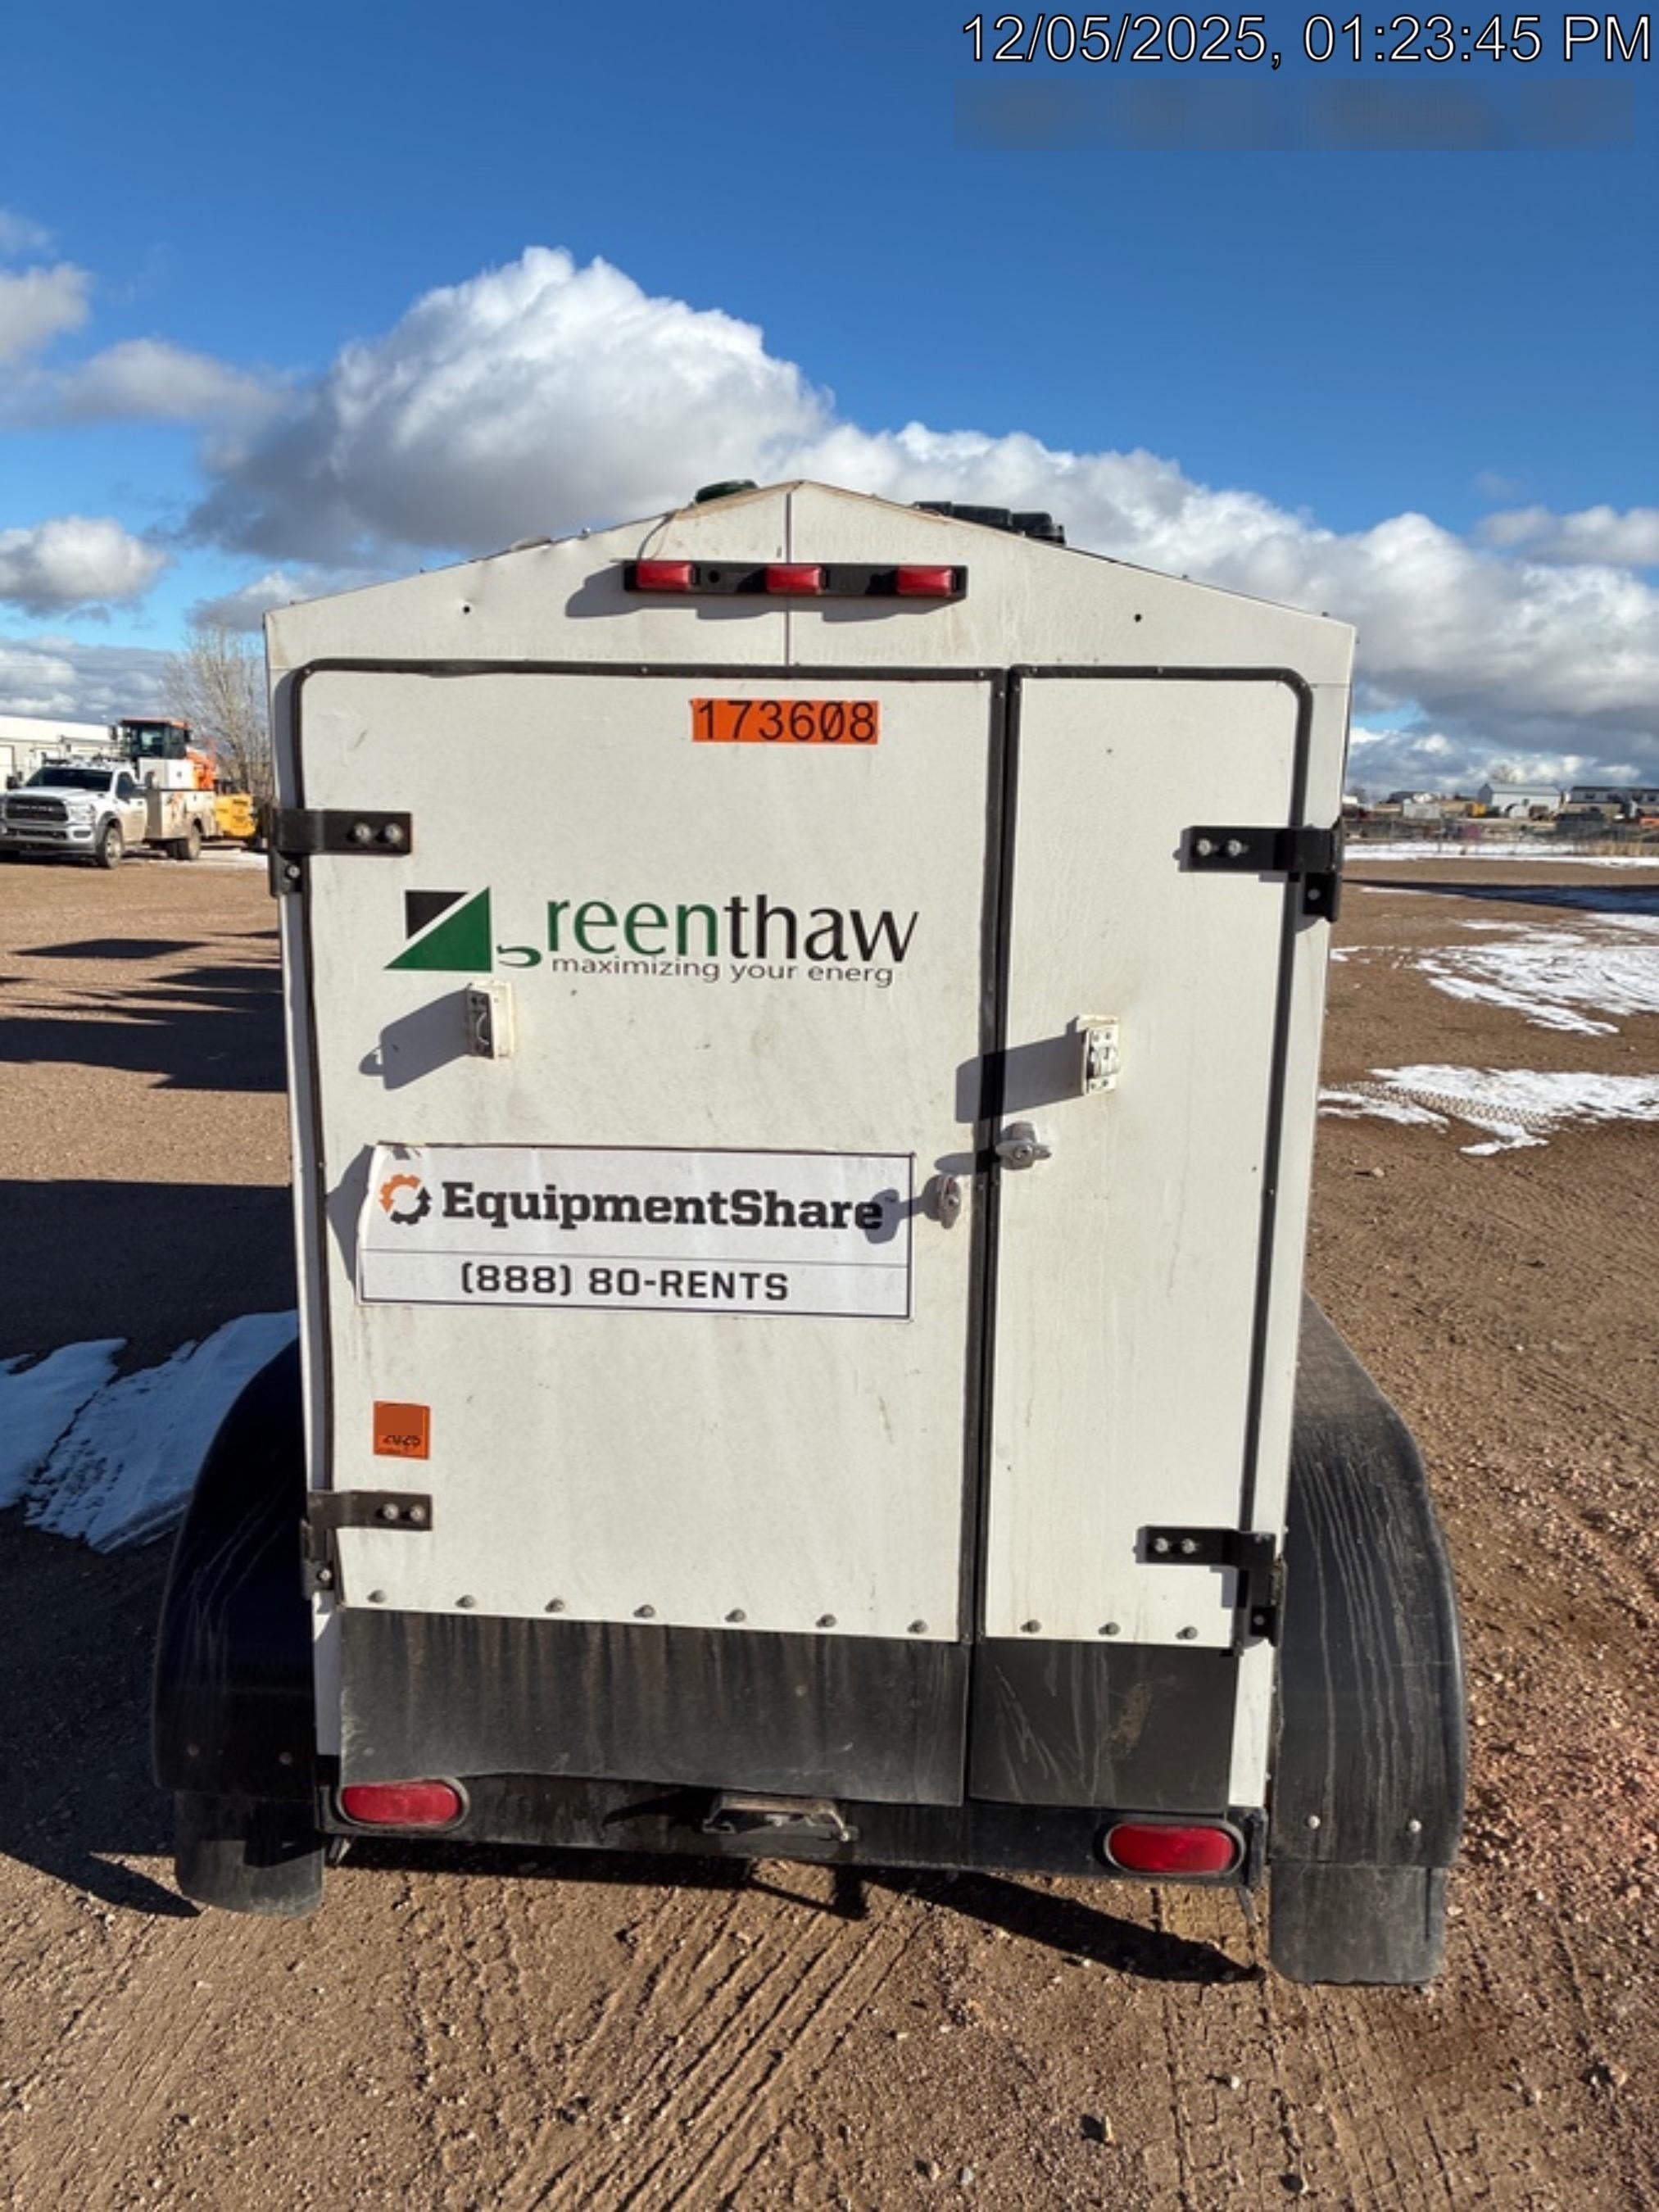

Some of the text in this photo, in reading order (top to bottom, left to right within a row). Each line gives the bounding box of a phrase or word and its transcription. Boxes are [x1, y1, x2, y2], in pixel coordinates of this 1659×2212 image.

[698, 699, 876, 741] 173608
[552, 957, 893, 989] maximizing your energ
[442, 1181, 884, 1229] EquipmentShare
[462, 1262, 788, 1302] (888) 80-RENTS
